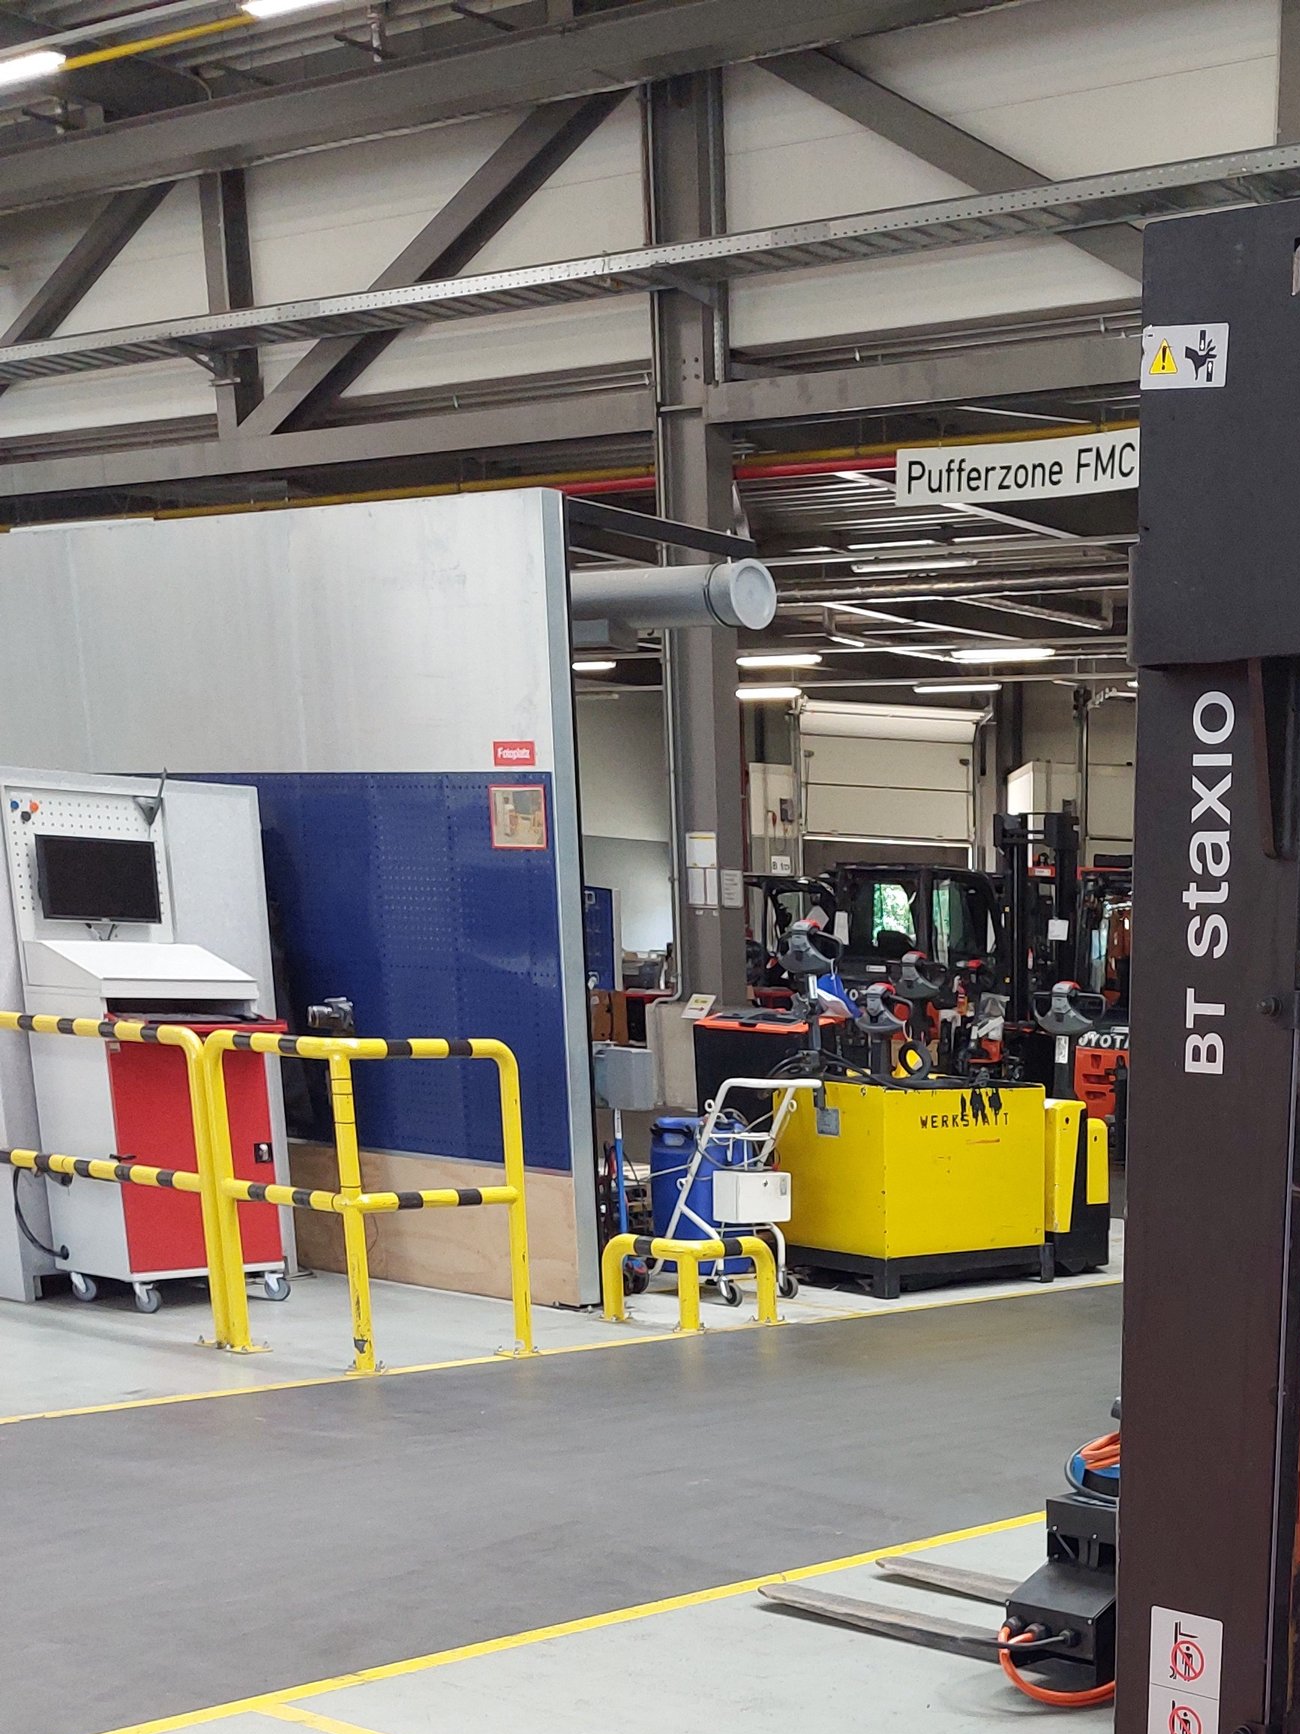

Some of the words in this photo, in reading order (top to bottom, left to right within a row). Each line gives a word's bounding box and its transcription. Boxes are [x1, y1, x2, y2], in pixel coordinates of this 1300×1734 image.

[907, 457, 1063, 495] Pufferzone
[1076, 442, 1136, 484] FMC
[1183, 987, 1226, 1075] BT
